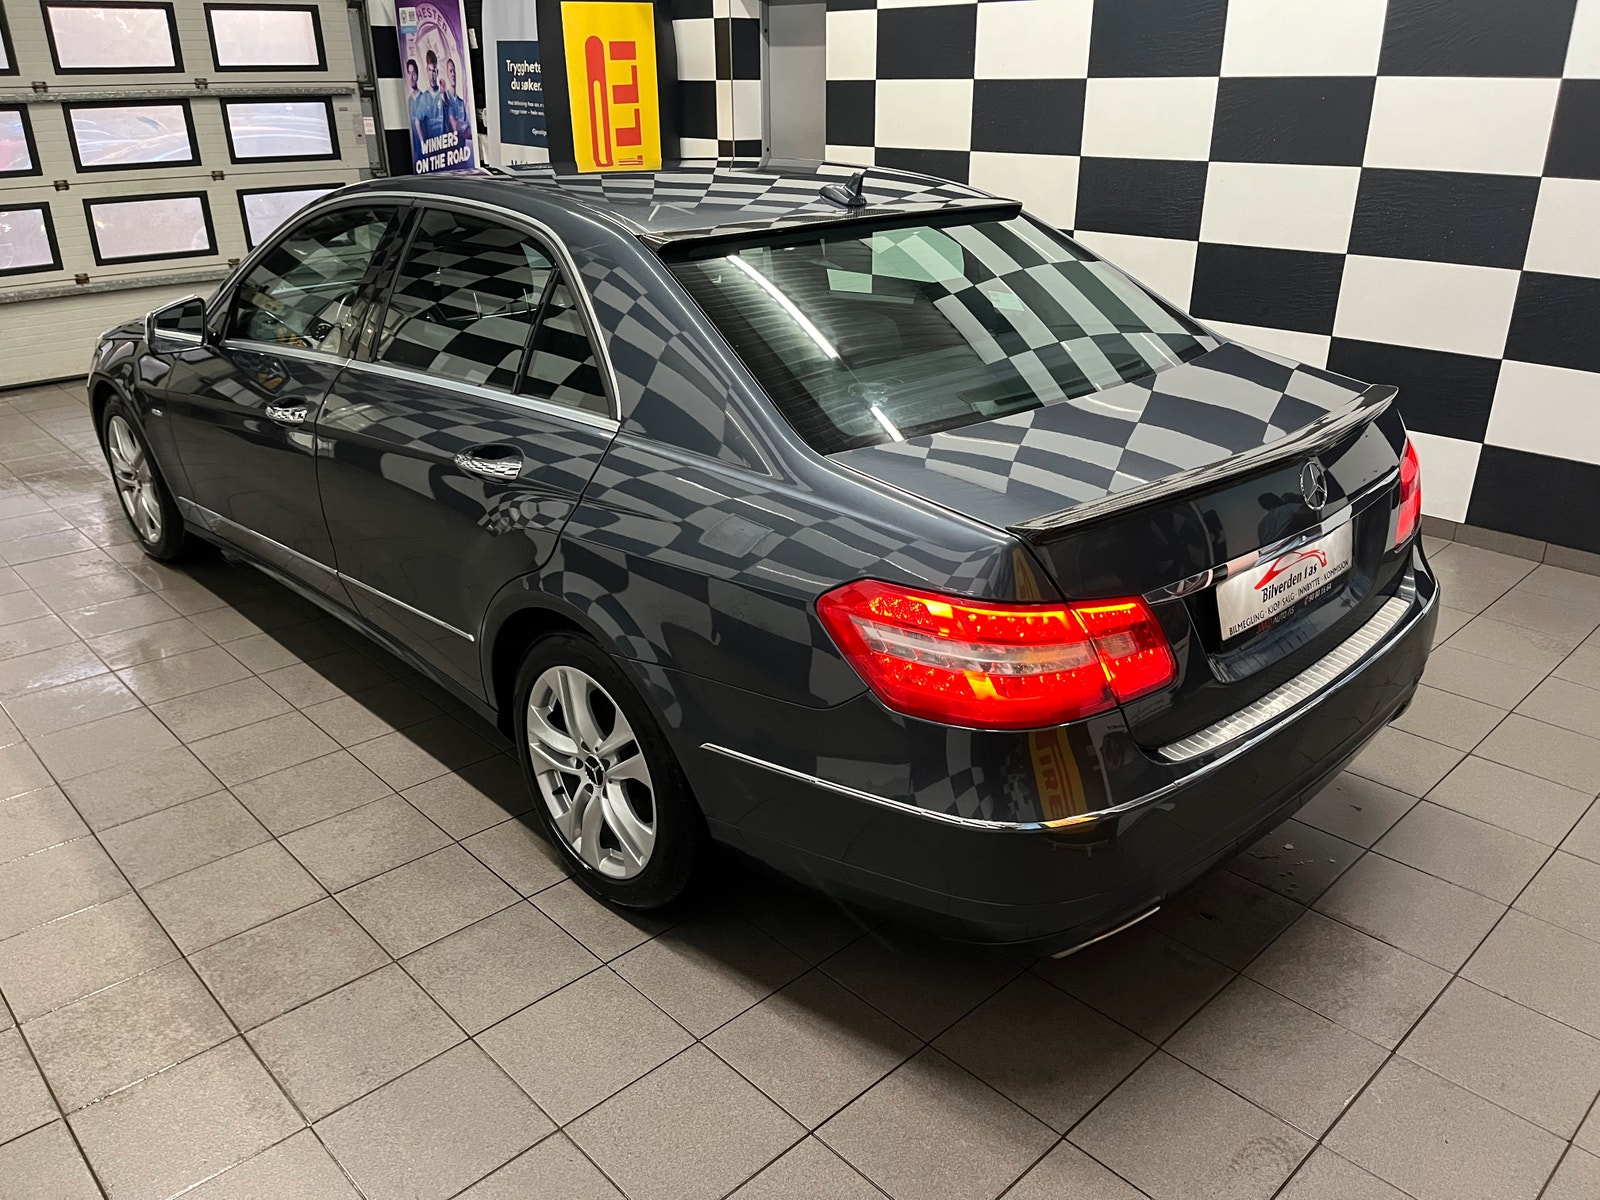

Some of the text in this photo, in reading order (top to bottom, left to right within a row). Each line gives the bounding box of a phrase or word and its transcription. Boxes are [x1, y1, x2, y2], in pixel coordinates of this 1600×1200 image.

[511, 78, 520, 91] du
[421, 131, 459, 155] WINNERS
[416, 146, 471, 175] ON THE ROAD
[1261, 572, 1302, 603] Bilverden
[1229, 610, 1265, 635] BILMEGLING
